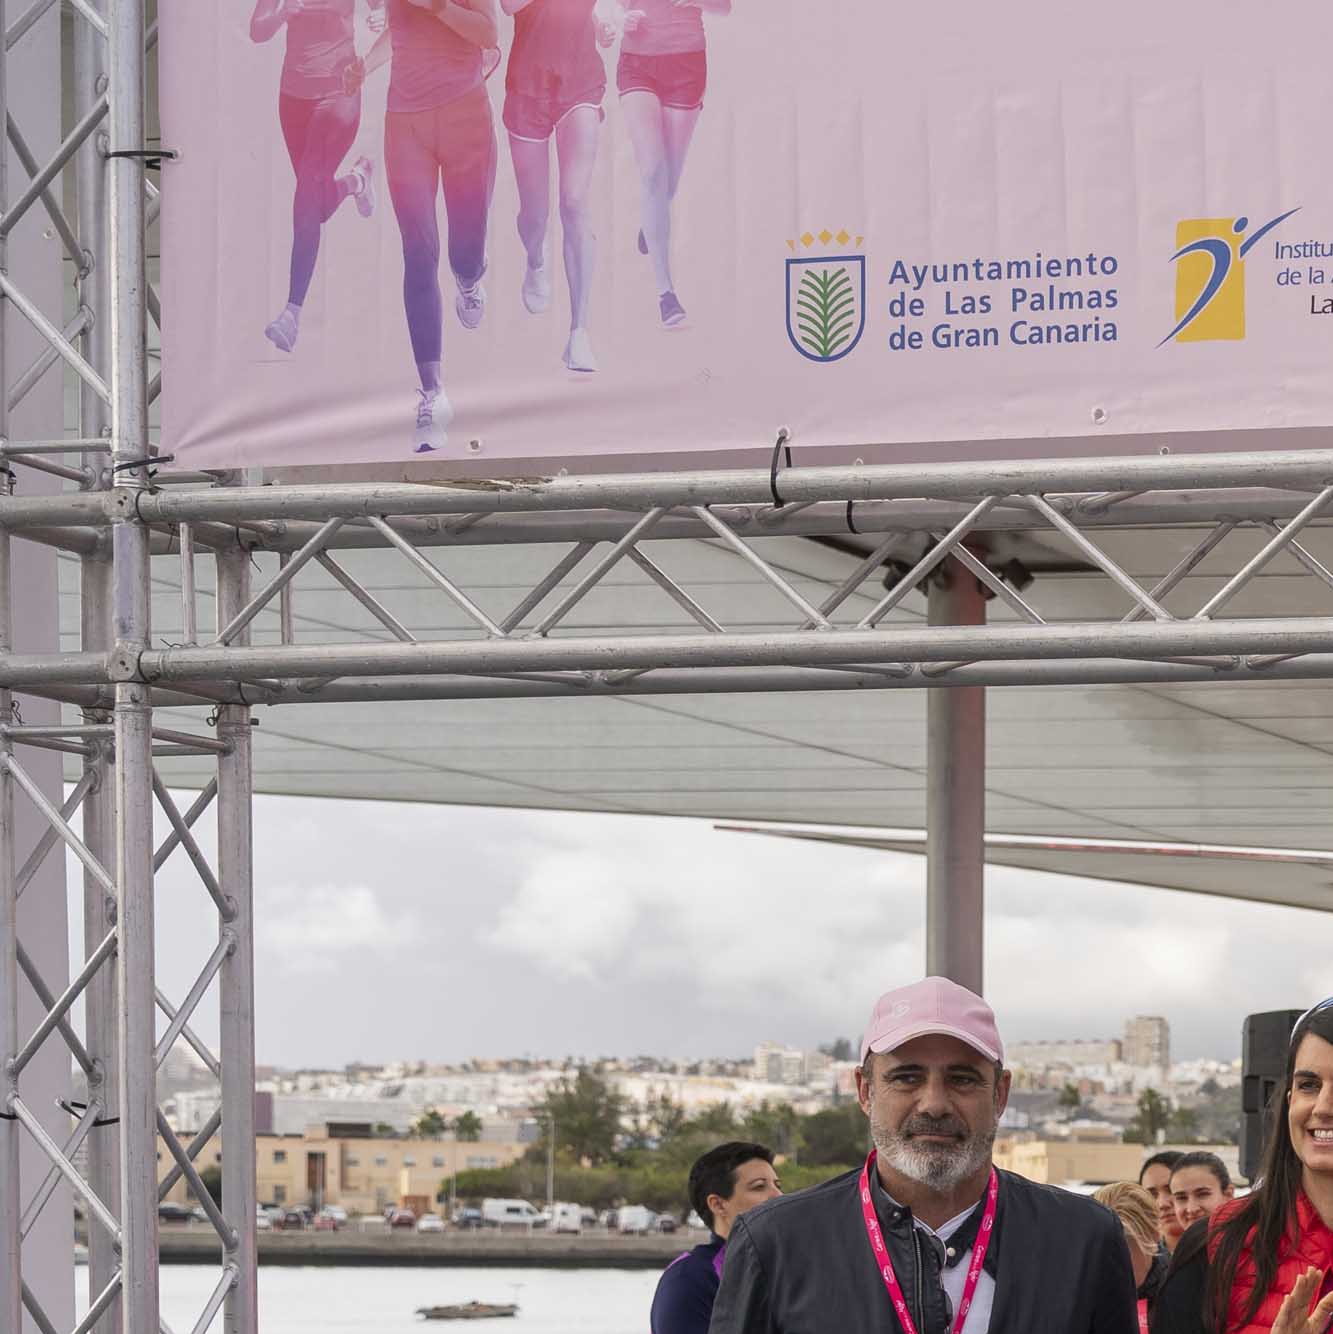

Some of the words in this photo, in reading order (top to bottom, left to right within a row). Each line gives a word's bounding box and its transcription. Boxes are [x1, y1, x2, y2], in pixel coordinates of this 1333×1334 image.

[888, 252, 1118, 288] Ayuntamiento
[1277, 267, 1302, 286] de
[1307, 265, 1326, 284] la
[888, 293, 924, 317] de
[944, 288, 991, 315] Las
[1012, 284, 1118, 311] Palmas
[889, 324, 924, 350] de
[931, 322, 1000, 347] Gran
[1009, 317, 1118, 344] Canaria
